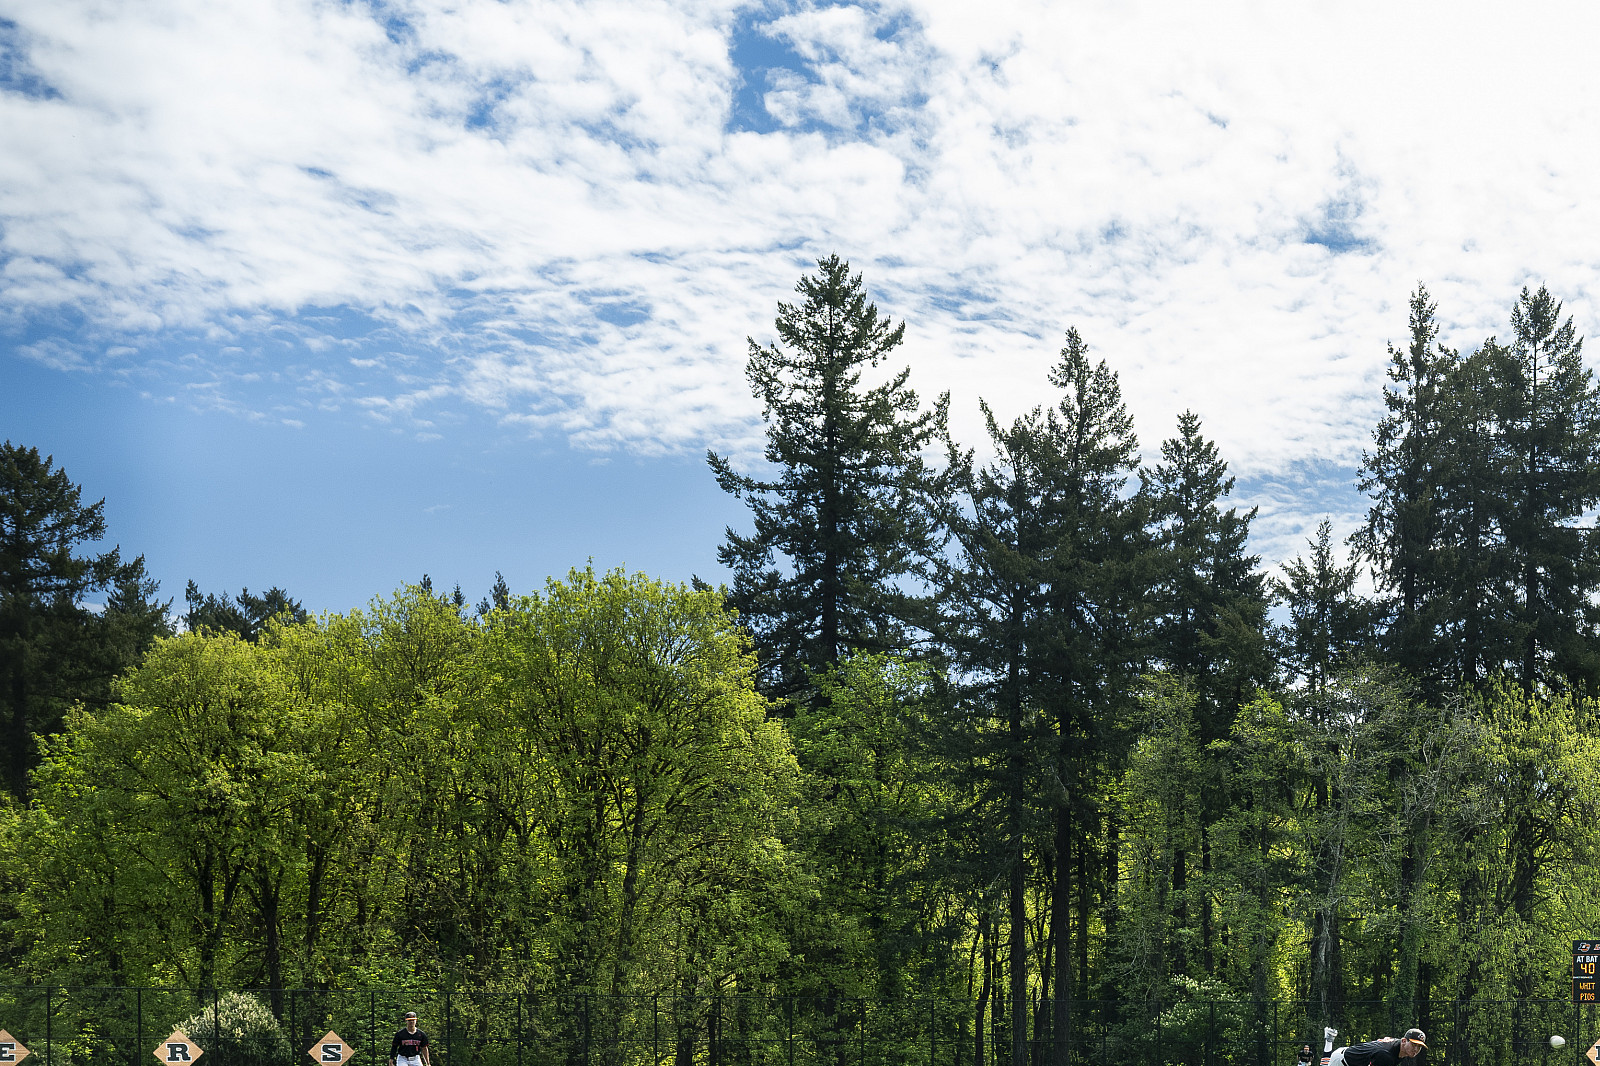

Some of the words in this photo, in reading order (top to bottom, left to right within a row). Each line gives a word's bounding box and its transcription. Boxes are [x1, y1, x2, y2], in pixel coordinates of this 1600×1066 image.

[1580, 963, 1595, 974] 40
[165, 1043, 192, 1062] R
[320, 1043, 343, 1063] S
